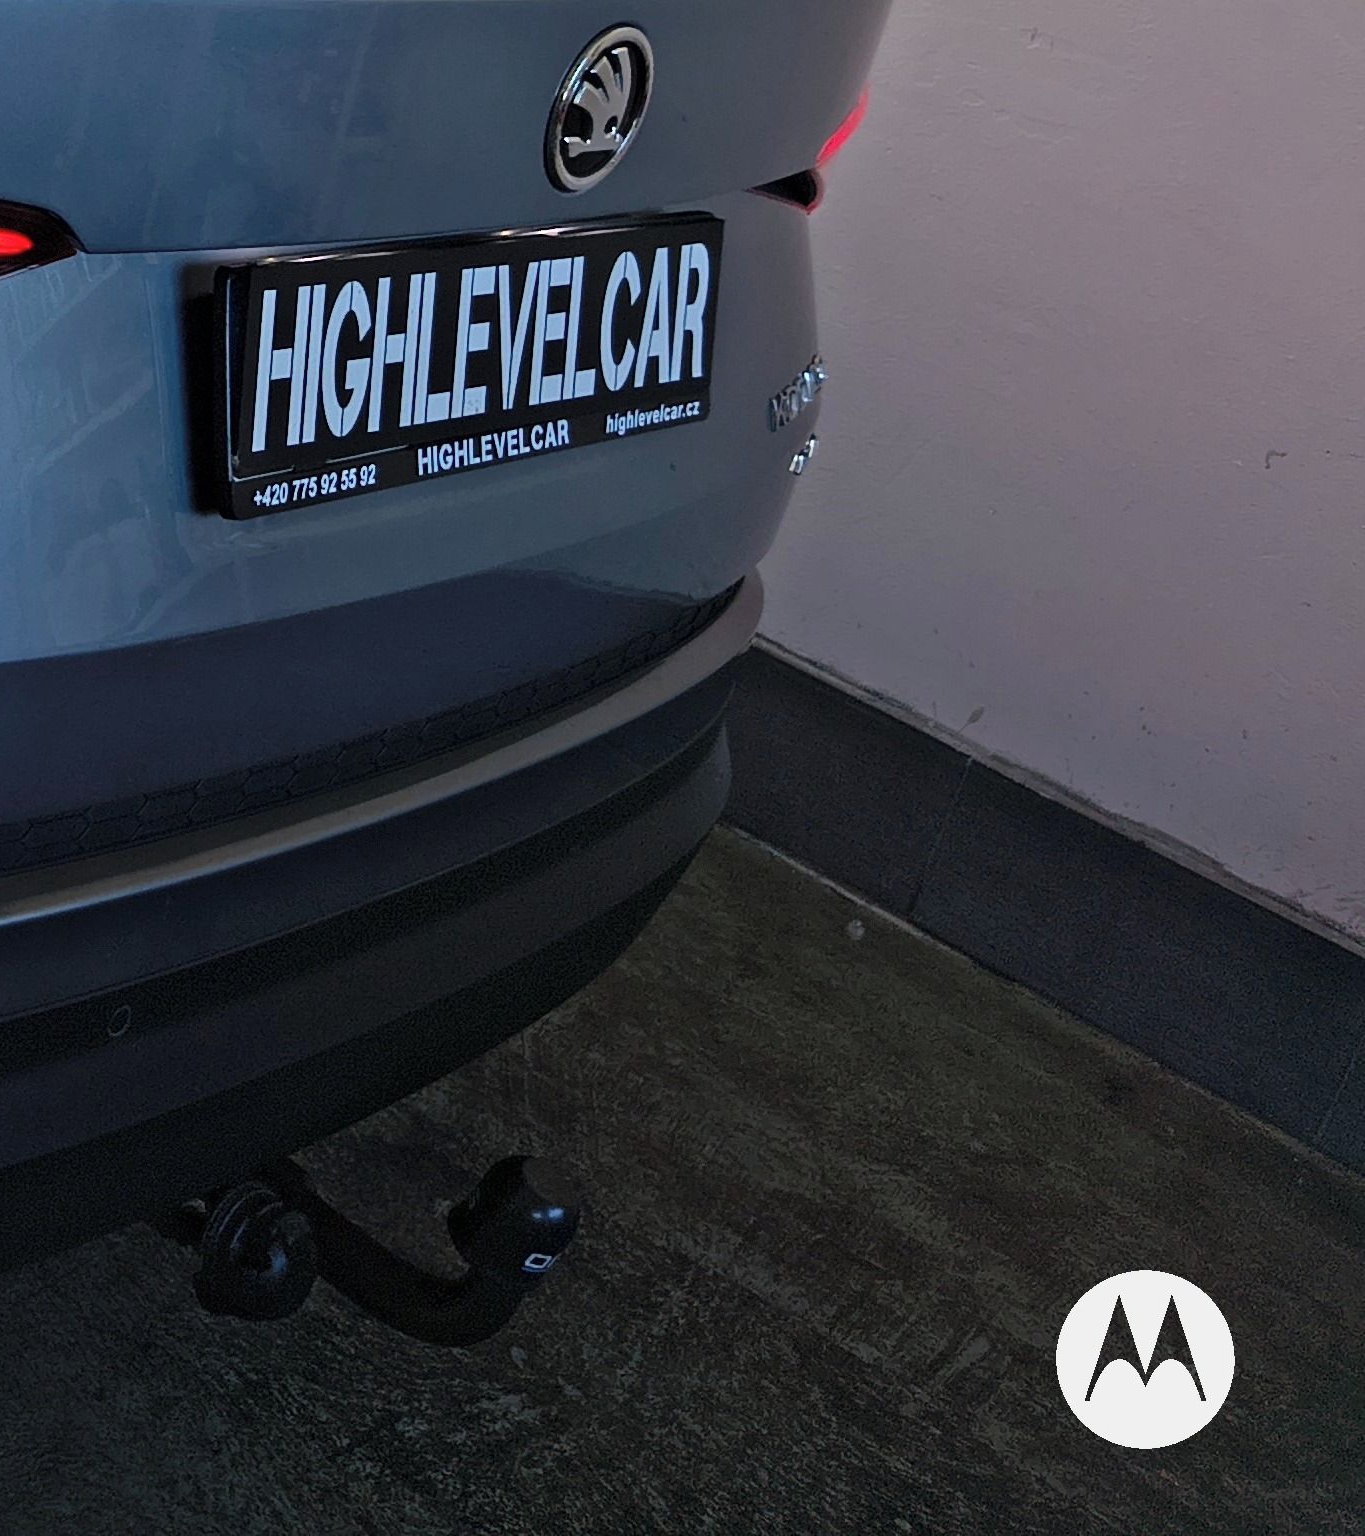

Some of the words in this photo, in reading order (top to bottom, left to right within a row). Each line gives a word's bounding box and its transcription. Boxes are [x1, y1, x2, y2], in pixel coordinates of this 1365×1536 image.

[605, 400, 700, 435] highlevelcar.cz
[253, 482, 289, 506] +420
[292, 476, 318, 501] 775
[320, 471, 338, 495] 92
[340, 467, 357, 491] 55
[360, 463, 376, 486] 92
